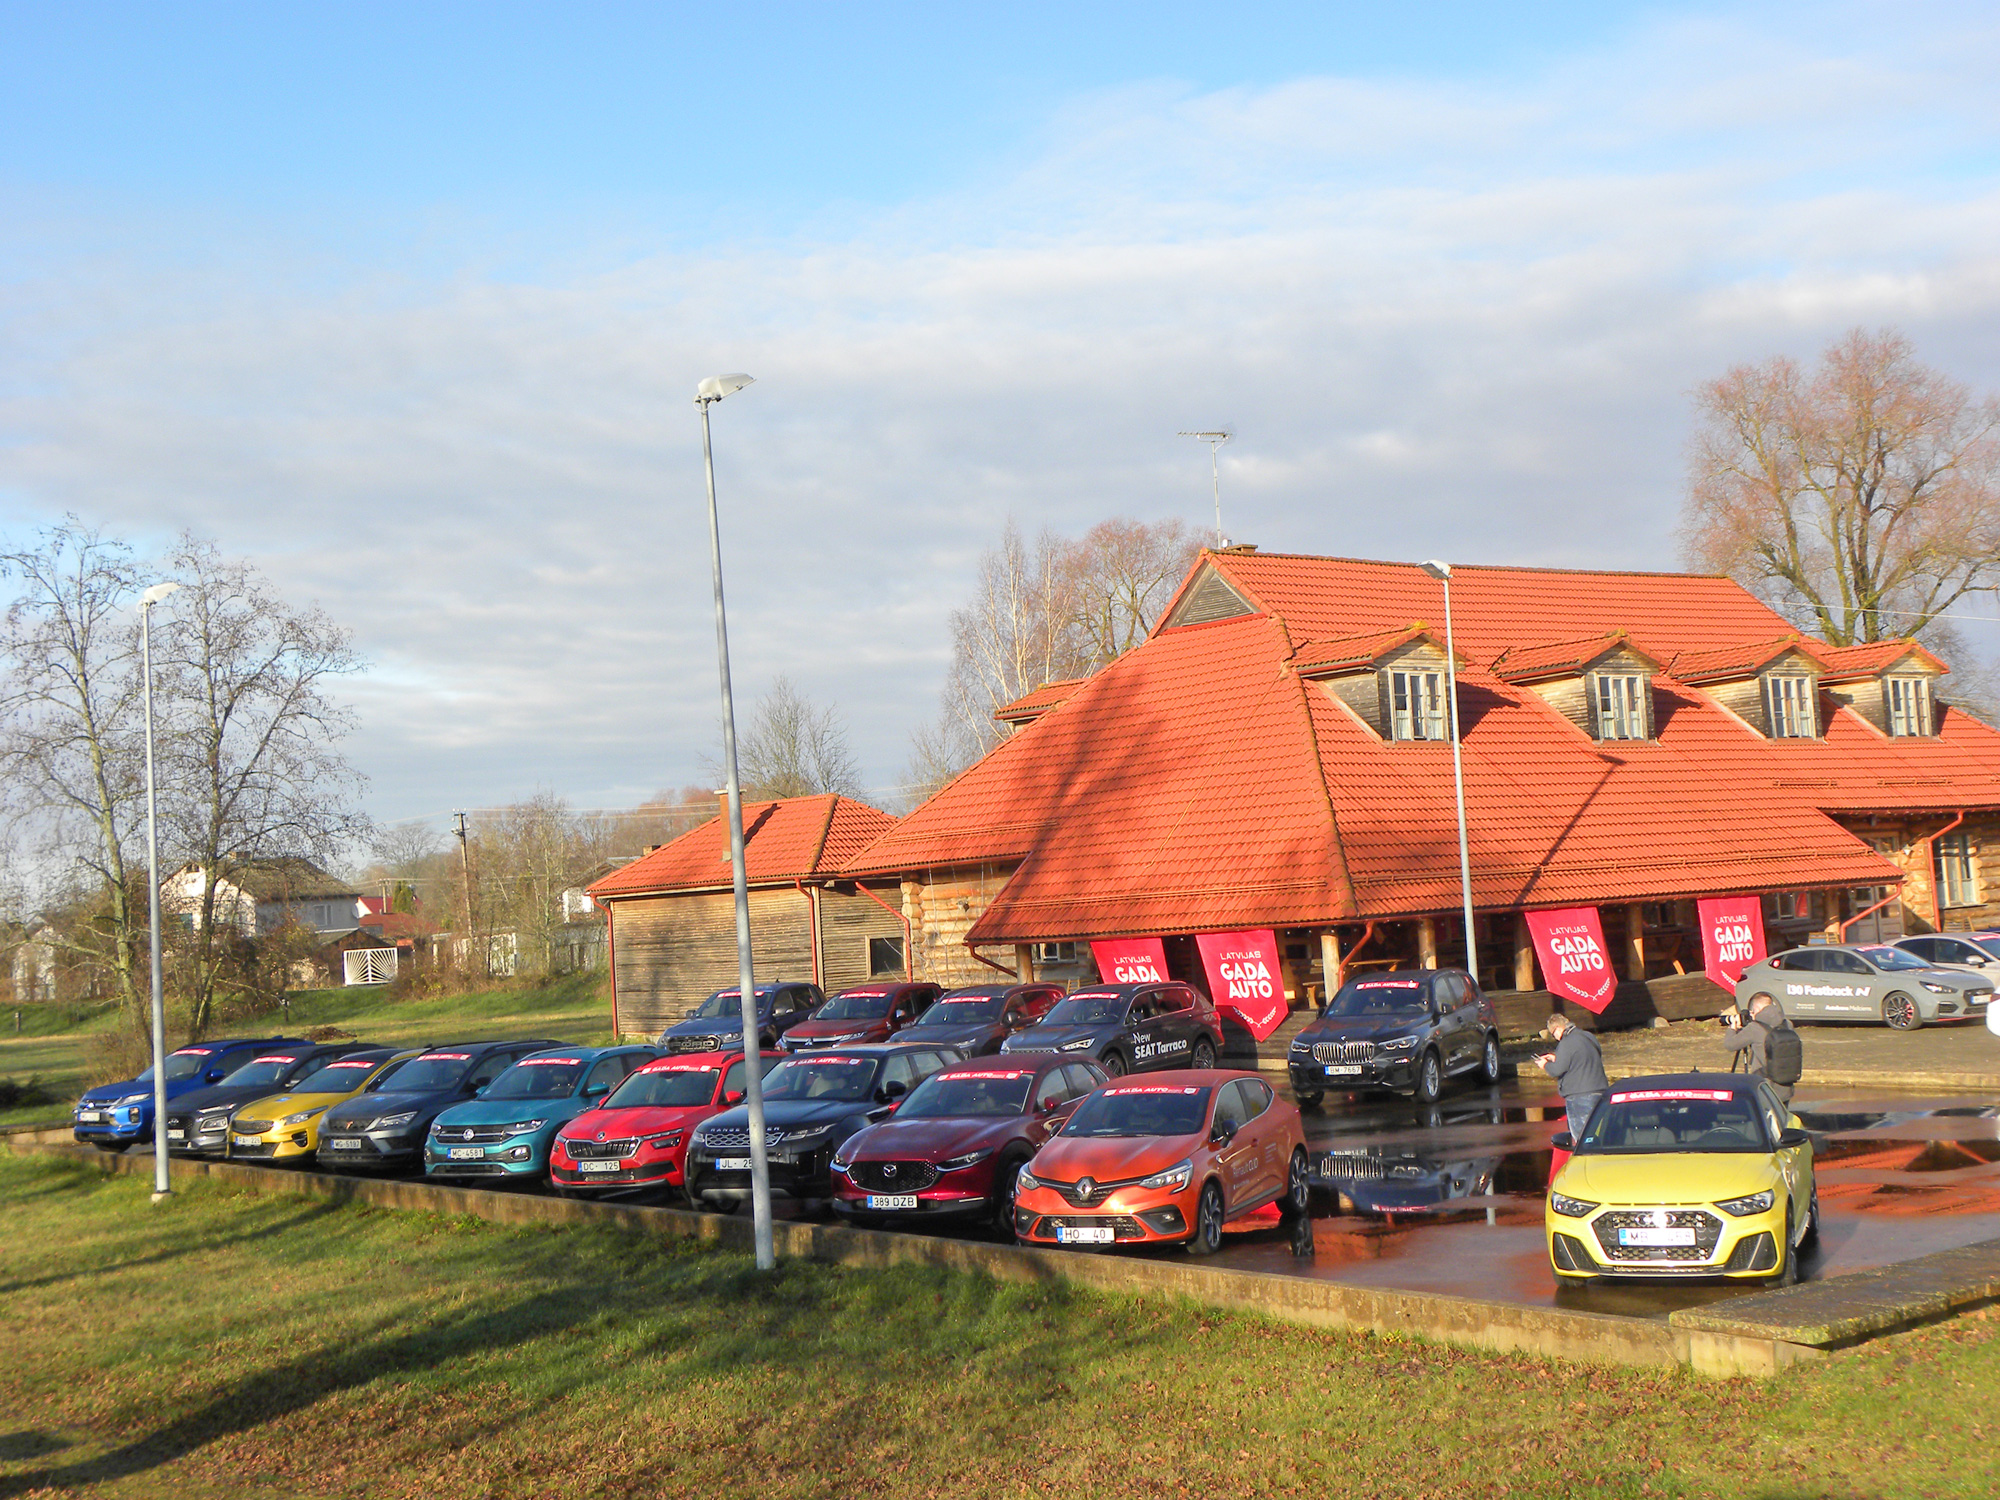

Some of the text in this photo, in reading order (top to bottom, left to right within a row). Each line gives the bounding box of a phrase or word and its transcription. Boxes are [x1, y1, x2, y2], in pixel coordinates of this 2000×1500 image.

[1715, 914, 1748, 924] LATVIJAS
[1549, 925, 1588, 936] LATVIJAS
[1714, 924, 1753, 944] GADA
[1550, 934, 1601, 956] GADA
[1220, 951, 1262, 960] LATVIJAS
[1719, 943, 1754, 963] AUTO
[1114, 955, 1152, 965] LATVIJAS
[1560, 953, 1604, 974] AUTO
[1114, 965, 1162, 983] GADA
[1220, 961, 1272, 981] GADA
[1229, 979, 1273, 999] AUTO
[1804, 984, 1855, 997] Fastback
[1132, 1032, 1151, 1044] New
[1134, 1039, 1187, 1059] SEAT Tarraco
[452, 1149, 482, 1157] MC-4581
[604, 1161, 619, 1170] 125
[874, 1196, 914, 1207] 389 DZB
[1093, 1229, 1106, 1239] 40
